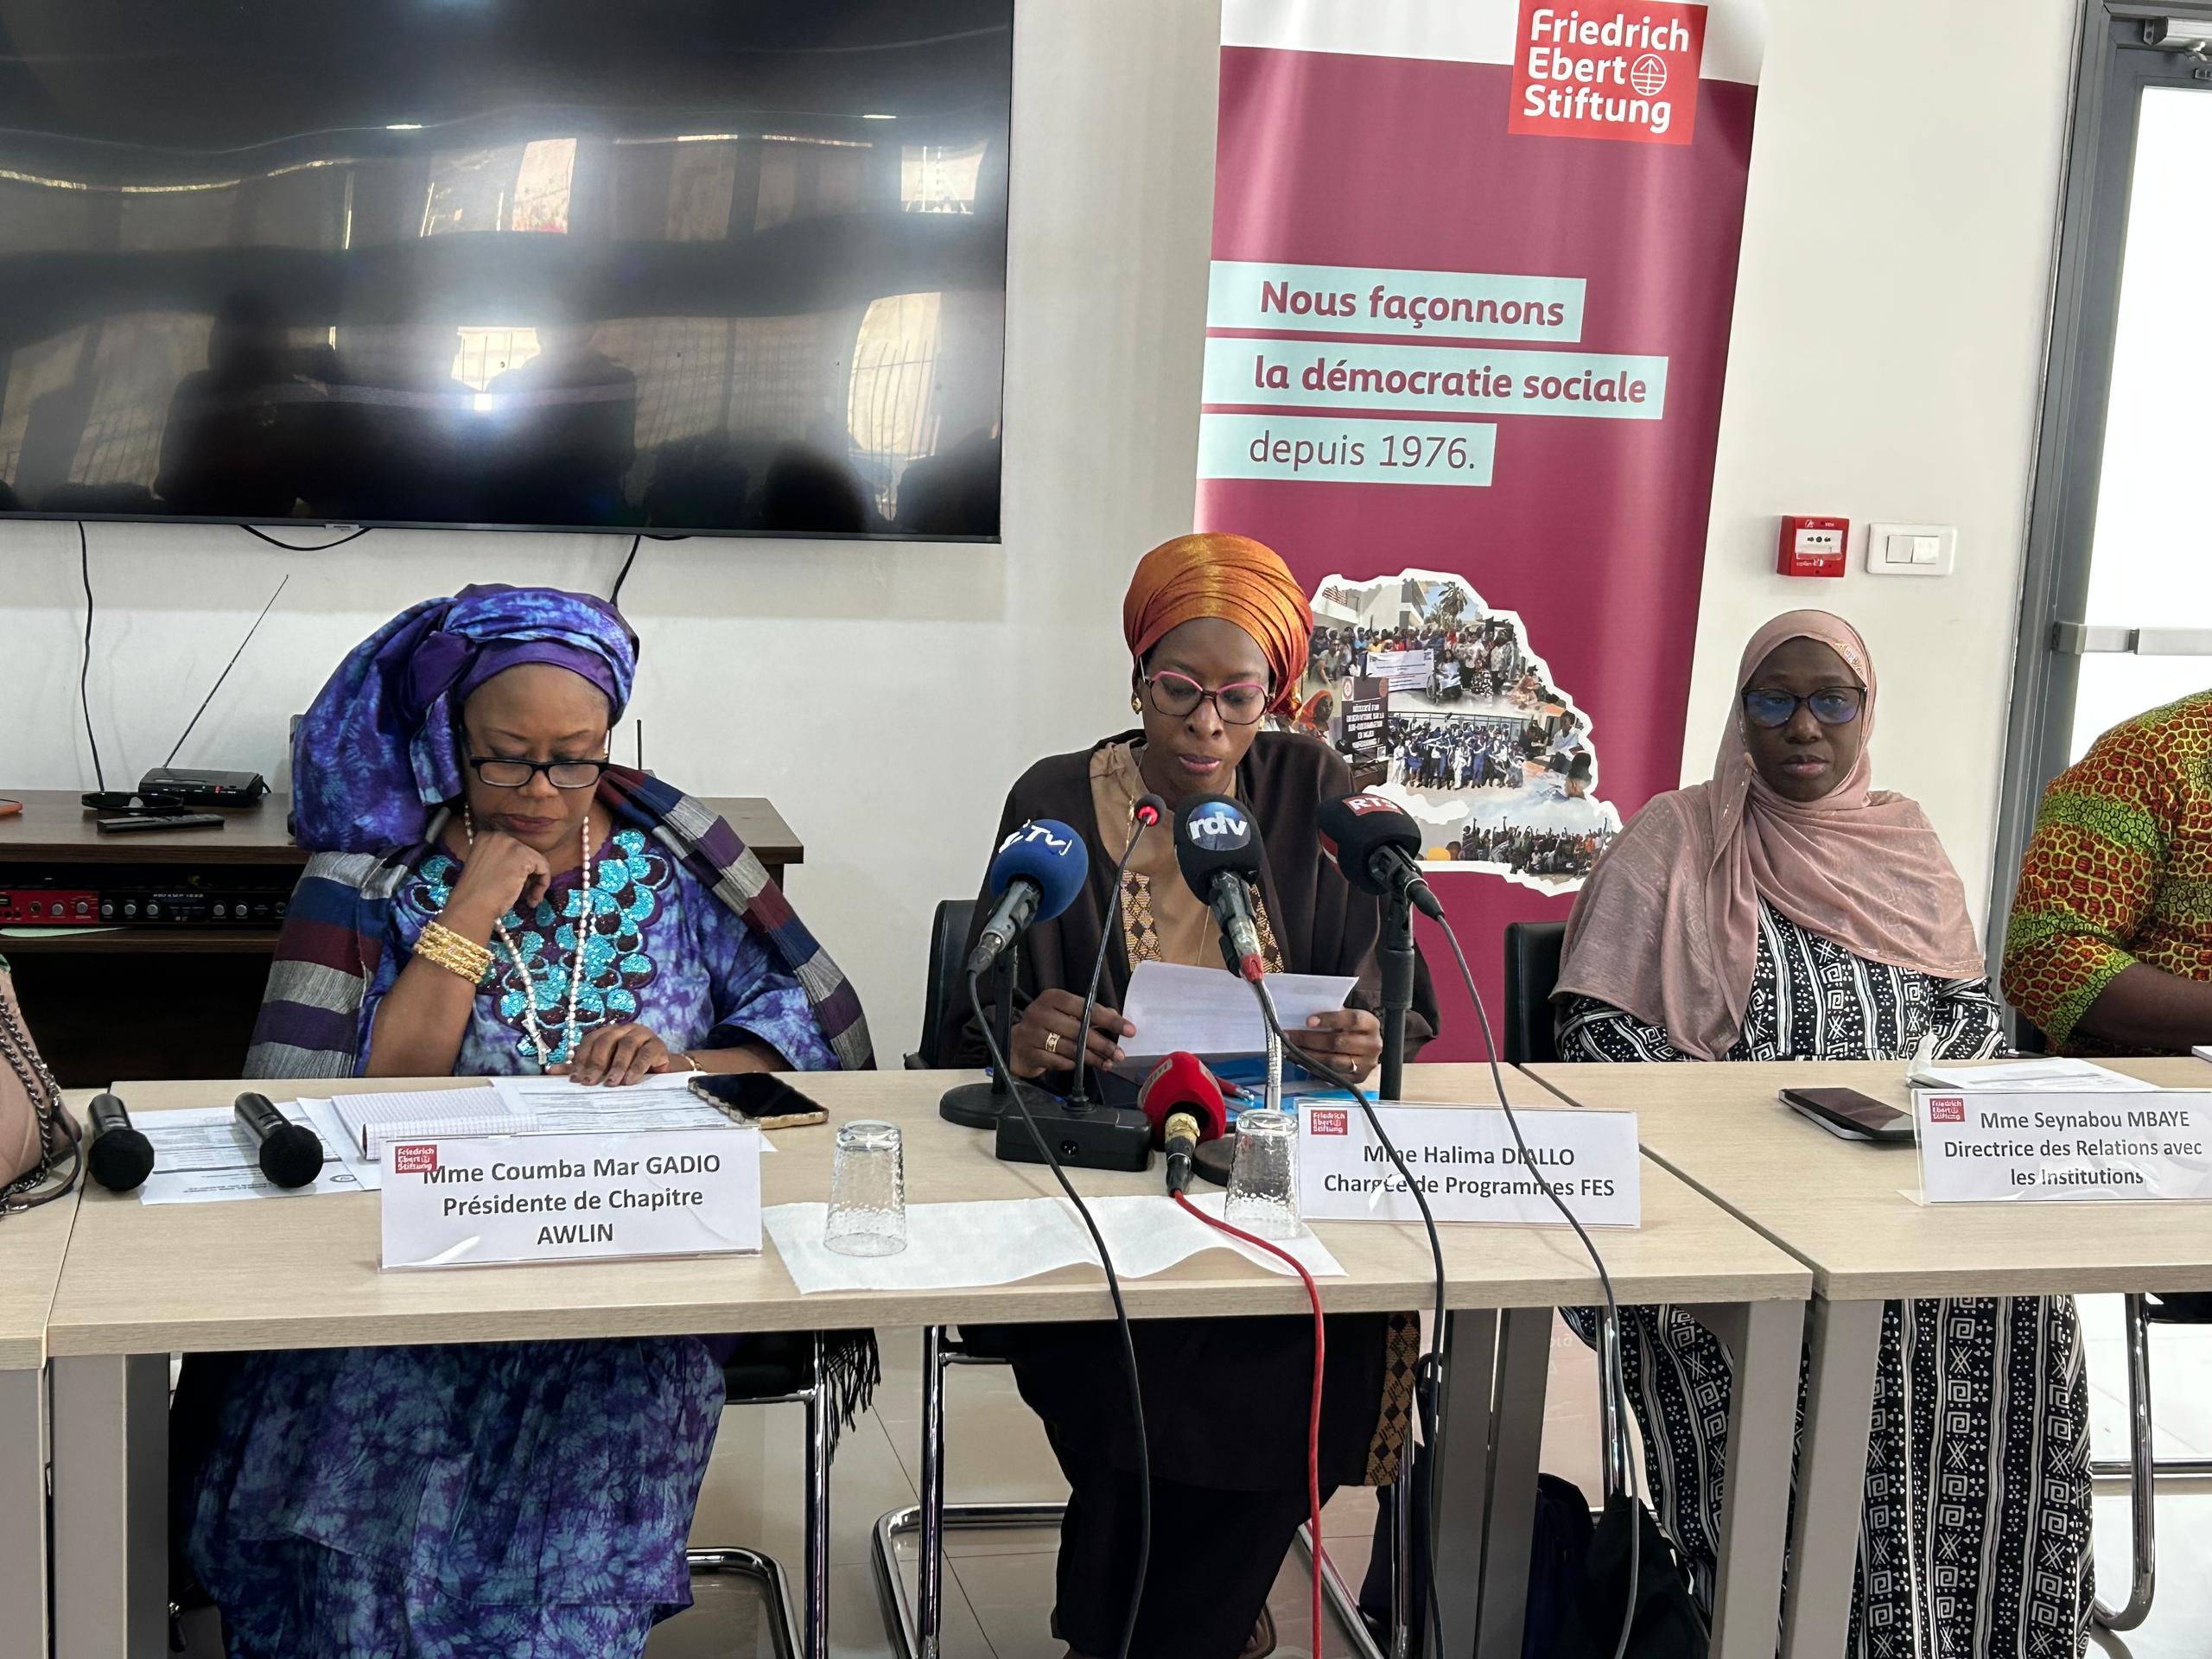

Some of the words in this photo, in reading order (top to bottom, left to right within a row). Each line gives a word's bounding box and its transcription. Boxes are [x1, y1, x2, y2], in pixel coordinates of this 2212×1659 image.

[1530, 9, 1689, 52] Friedrich
[1528, 47, 1627, 85] Ebert
[1523, 84, 1672, 134] Stiftung
[1261, 280, 1357, 317] Nous
[1369, 285, 1565, 328] façonnons
[1255, 355, 1289, 389] la
[1301, 358, 1512, 397] démocratie
[1523, 370, 1646, 403] sociale
[1249, 429, 1364, 472] depuis
[1379, 435, 1475, 469] 1976.
[1348, 797, 1399, 810] RTS
[1189, 811, 1248, 840] rdv
[1980, 1112, 2029, 1128] Mme
[2034, 1110, 2122, 1132] Seynabou
[2127, 1110, 2190, 1128] MBAYE
[1424, 1146, 1495, 1164] Halima
[1502, 1147, 1575, 1166] DIALLO
[1944, 1141, 2034, 1157] Directrice
[2040, 1139, 2071, 1156] des
[2076, 1139, 2158, 1156] Relations
[2164, 1142, 2202, 1155] avec
[423, 1164, 484, 1185] Mme
[492, 1159, 586, 1181] Coumba
[594, 1159, 639, 1178] Mar
[646, 1154, 721, 1175] GADIO
[2011, 1168, 2036, 1185] les
[2041, 1168, 2144, 1185] Institutions
[1415, 1175, 1439, 1193] de
[1446, 1177, 1574, 1198] Programmes
[1581, 1179, 1615, 1197] FES
[443, 1193, 567, 1217] Présidente
[574, 1190, 601, 1211] de
[608, 1187, 703, 1211] Chapitre
[537, 1223, 613, 1245] AWLIN
